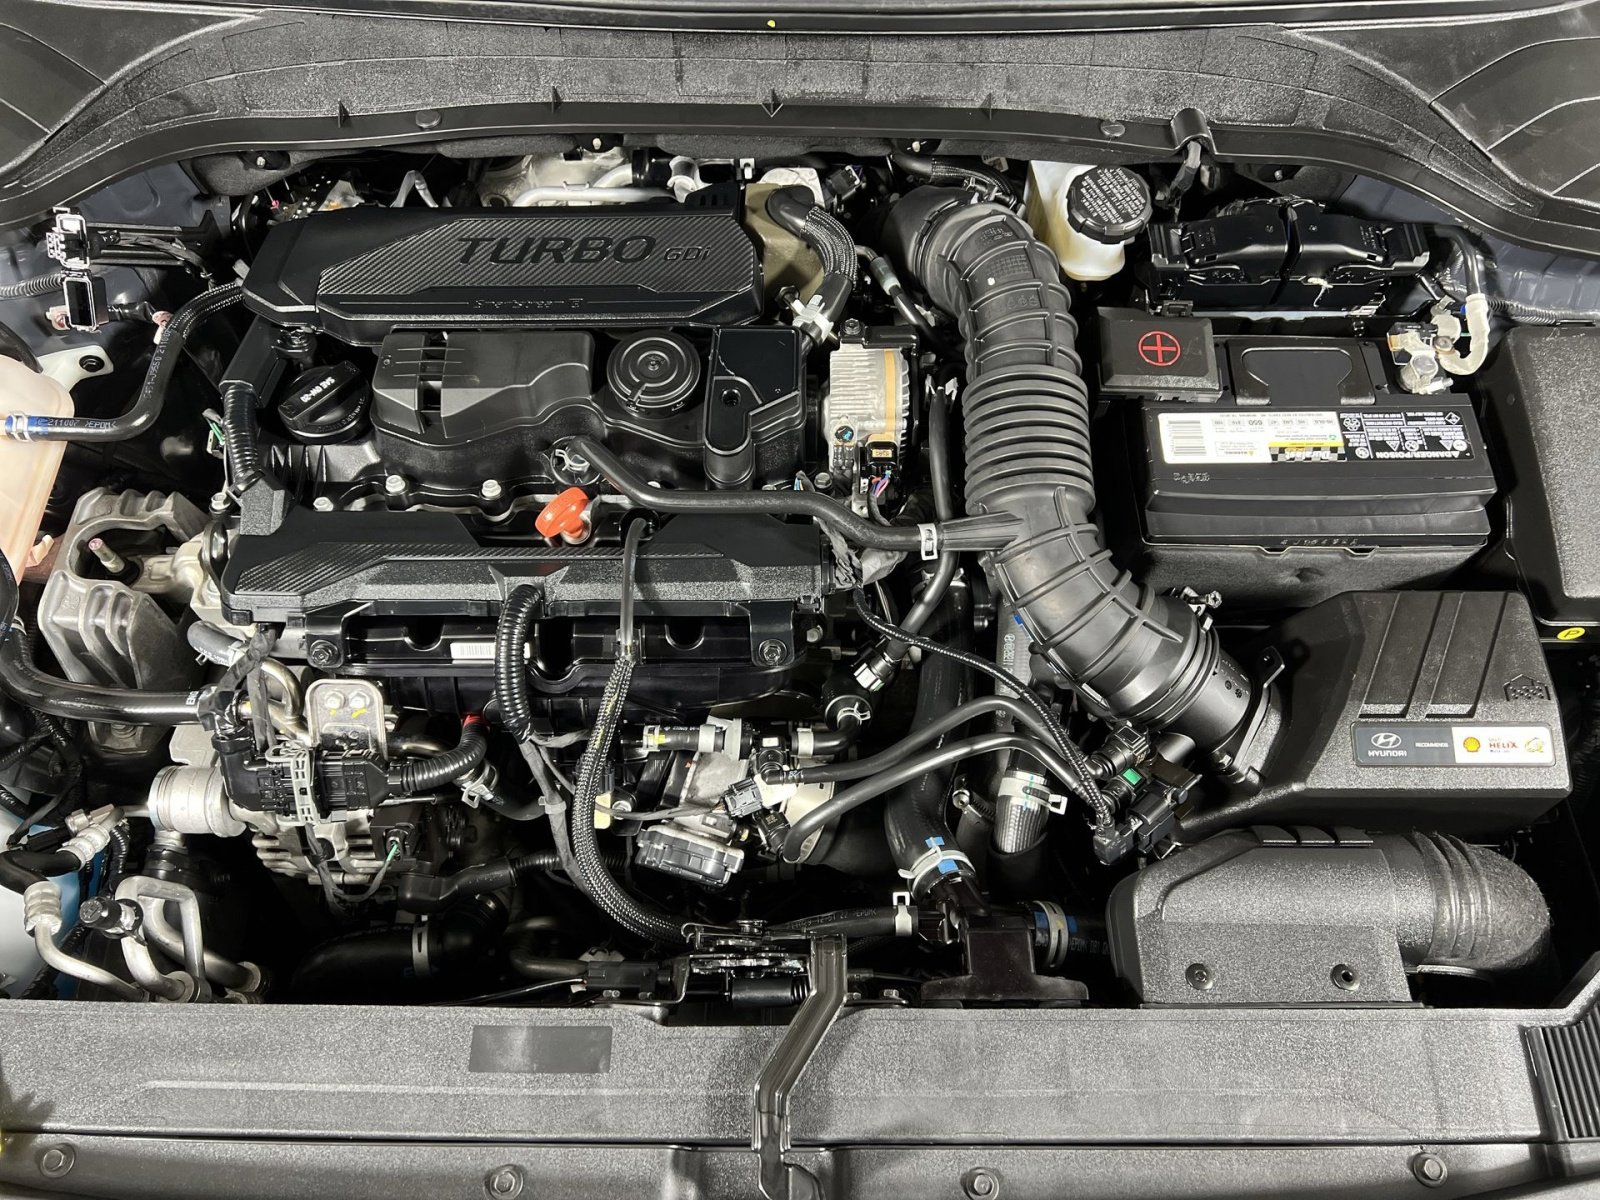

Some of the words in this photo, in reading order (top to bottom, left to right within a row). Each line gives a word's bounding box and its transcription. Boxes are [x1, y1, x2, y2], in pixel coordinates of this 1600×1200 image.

[458, 235, 656, 265] TURBO
[663, 245, 711, 261] GDi
[319, 376, 335, 389] SAE
[1285, 450, 1332, 460] Duralast
[1375, 451, 1452, 459] DANGER/POISON
[1489, 741, 1518, 749] HELIX
